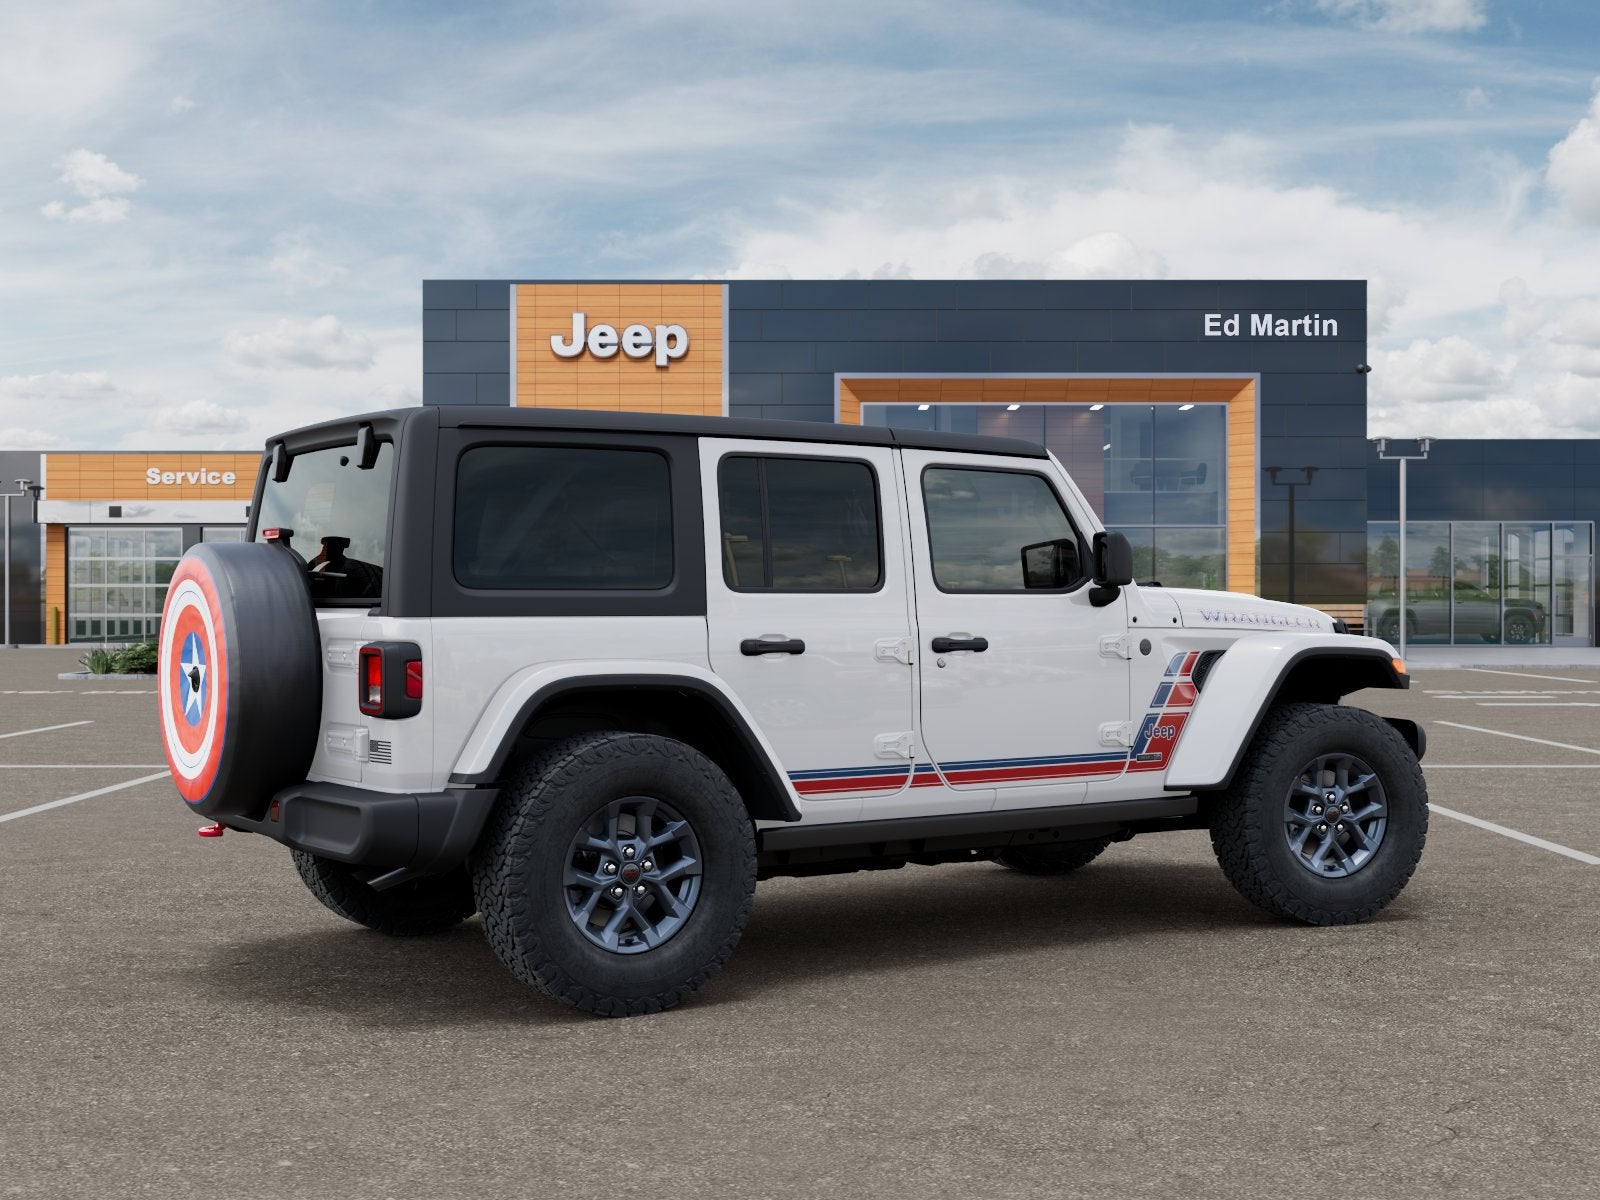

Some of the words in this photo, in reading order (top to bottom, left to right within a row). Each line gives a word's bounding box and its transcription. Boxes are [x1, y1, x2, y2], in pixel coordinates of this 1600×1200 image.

[1204, 313, 1240, 336] Ed
[1250, 313, 1338, 336] Martin
[550, 311, 690, 367] Jeep
[146, 467, 236, 485] Service
[1198, 609, 1322, 631] WRANGLER
[1144, 723, 1176, 740] Jeep
